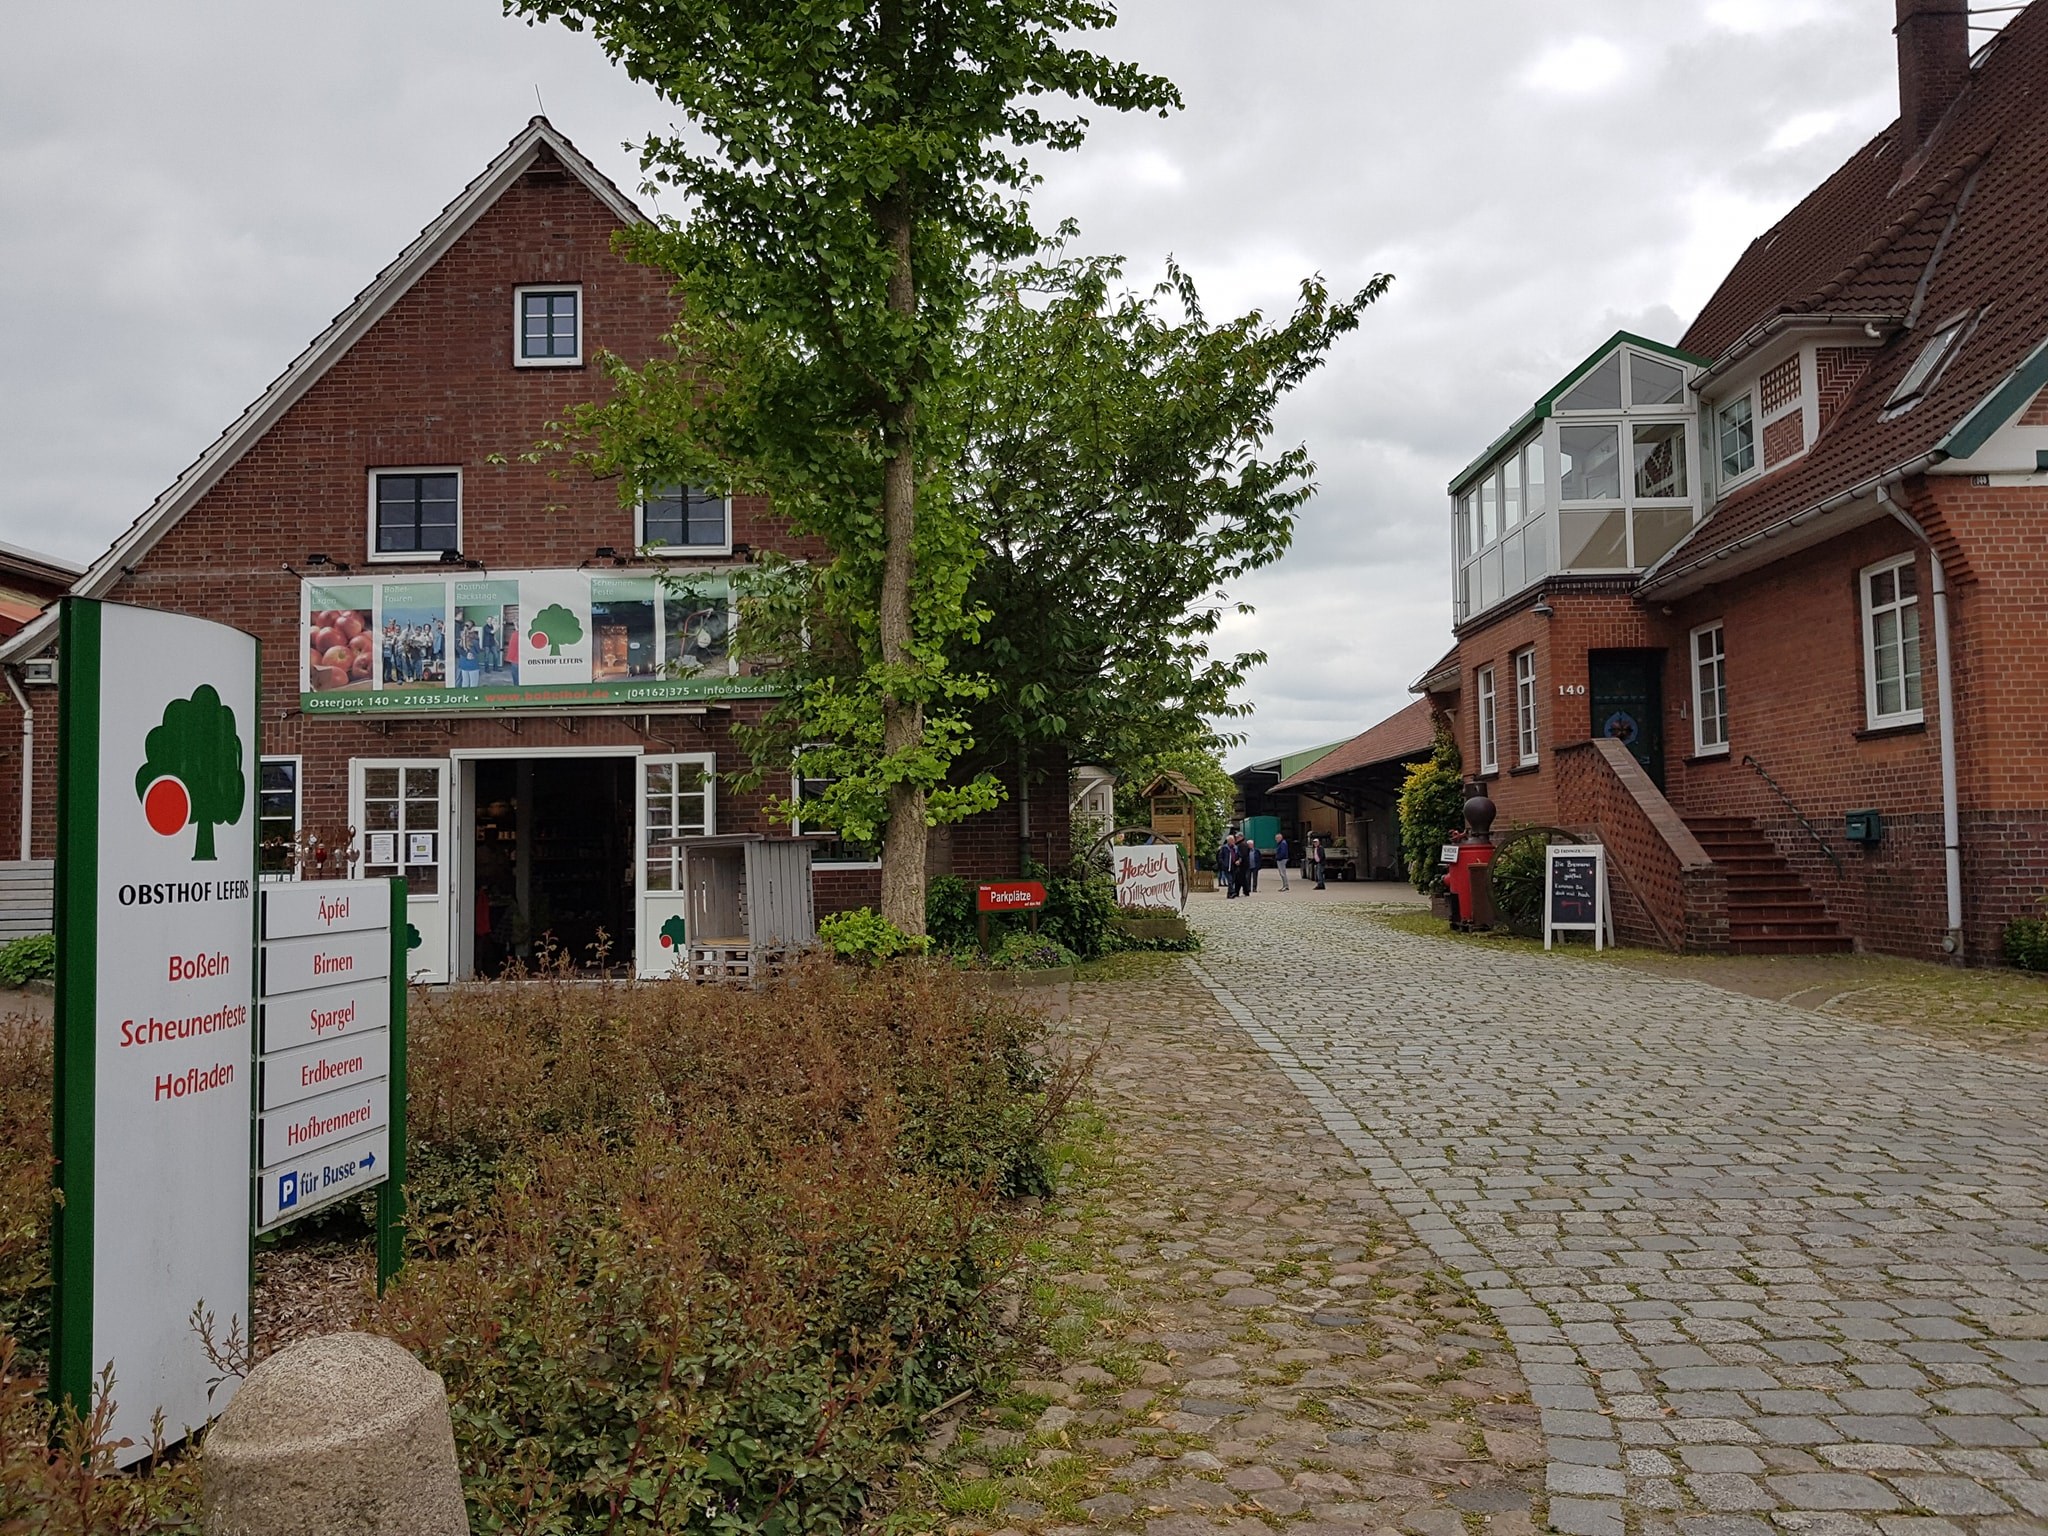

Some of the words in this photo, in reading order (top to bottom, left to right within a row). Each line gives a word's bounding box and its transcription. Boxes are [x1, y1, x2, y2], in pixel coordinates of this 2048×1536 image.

[384, 595, 413, 603] Touren
[456, 583, 489, 591] Obsthof
[456, 592, 497, 601] Backstage
[593, 588, 614, 596] Feste
[312, 598, 337, 606] Laden
[527, 658, 557, 666] OBSTHOF
[559, 657, 584, 665] LEFERS
[309, 697, 364, 710] Osterjork
[368, 697, 389, 706] 140
[404, 695, 441, 705] 21635
[443, 694, 469, 704] Jork
[627, 687, 690, 700] (04162)375
[1558, 684, 1585, 696] 140
[1116, 852, 1178, 885] Herzlich
[118, 881, 213, 906] OBSTHOF
[216, 879, 250, 901] LEFERS
[990, 889, 1031, 905] Parkplätze
[1117, 878, 1176, 908] Willkommen
[317, 895, 350, 927] Äpfel
[168, 951, 231, 982] Boßeln
[313, 952, 354, 976] Birnen
[119, 1003, 248, 1048] Scheunenfeste
[309, 999, 355, 1036] Spargel
[153, 1062, 235, 1102] Hofladen
[300, 1055, 363, 1088] Erdbeeren
[287, 1098, 372, 1147] Hofbrennerei
[299, 1171, 319, 1197] für
[322, 1160, 357, 1188] Busse
